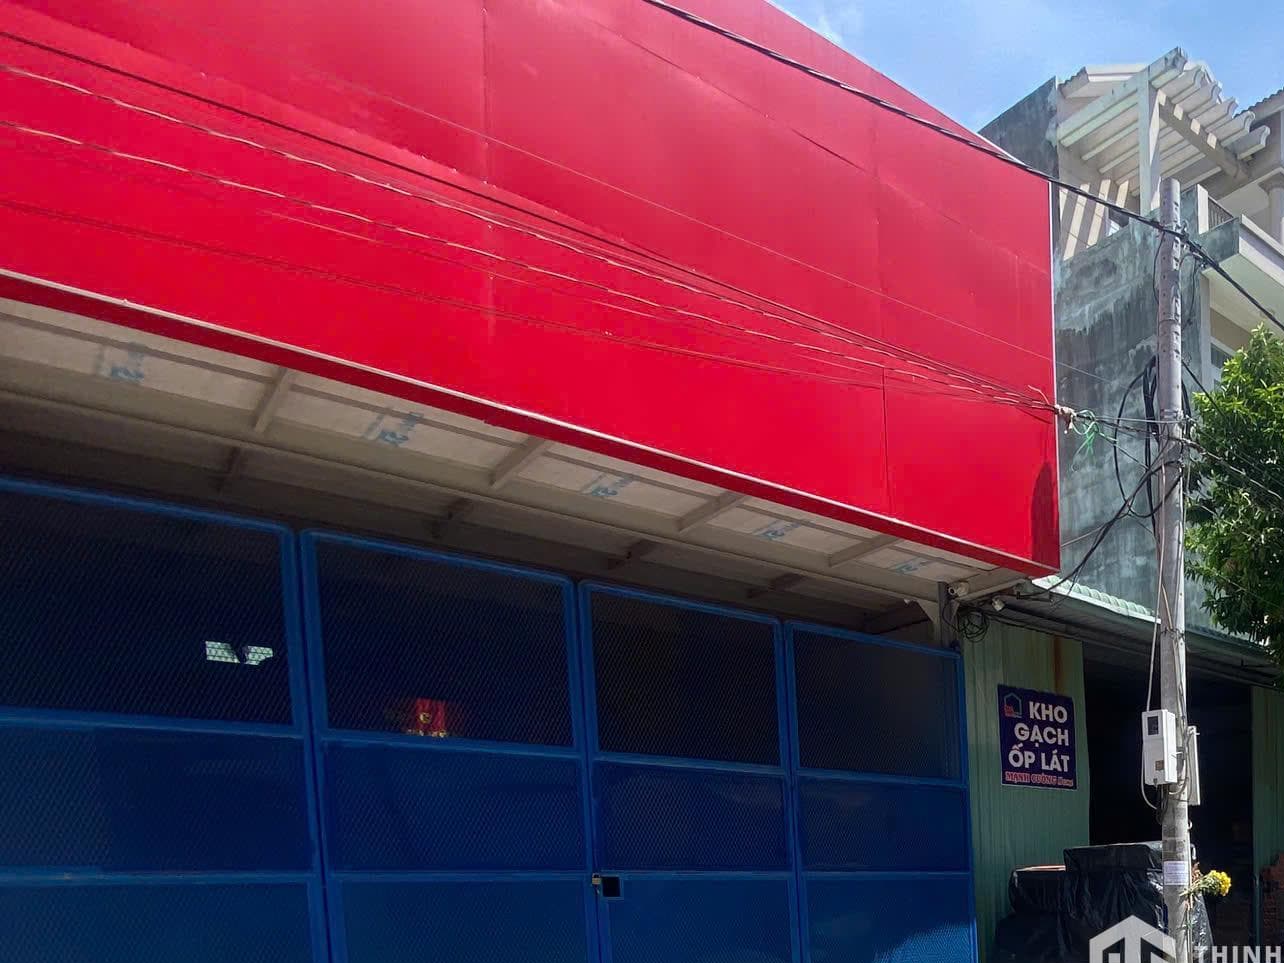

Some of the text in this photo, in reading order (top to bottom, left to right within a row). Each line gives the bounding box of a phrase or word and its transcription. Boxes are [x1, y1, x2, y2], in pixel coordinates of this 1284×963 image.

[1029, 701, 1068, 723] KHO
[1014, 722, 1069, 747] GẠCH
[1008, 742, 1070, 772] ỐP LÁT
